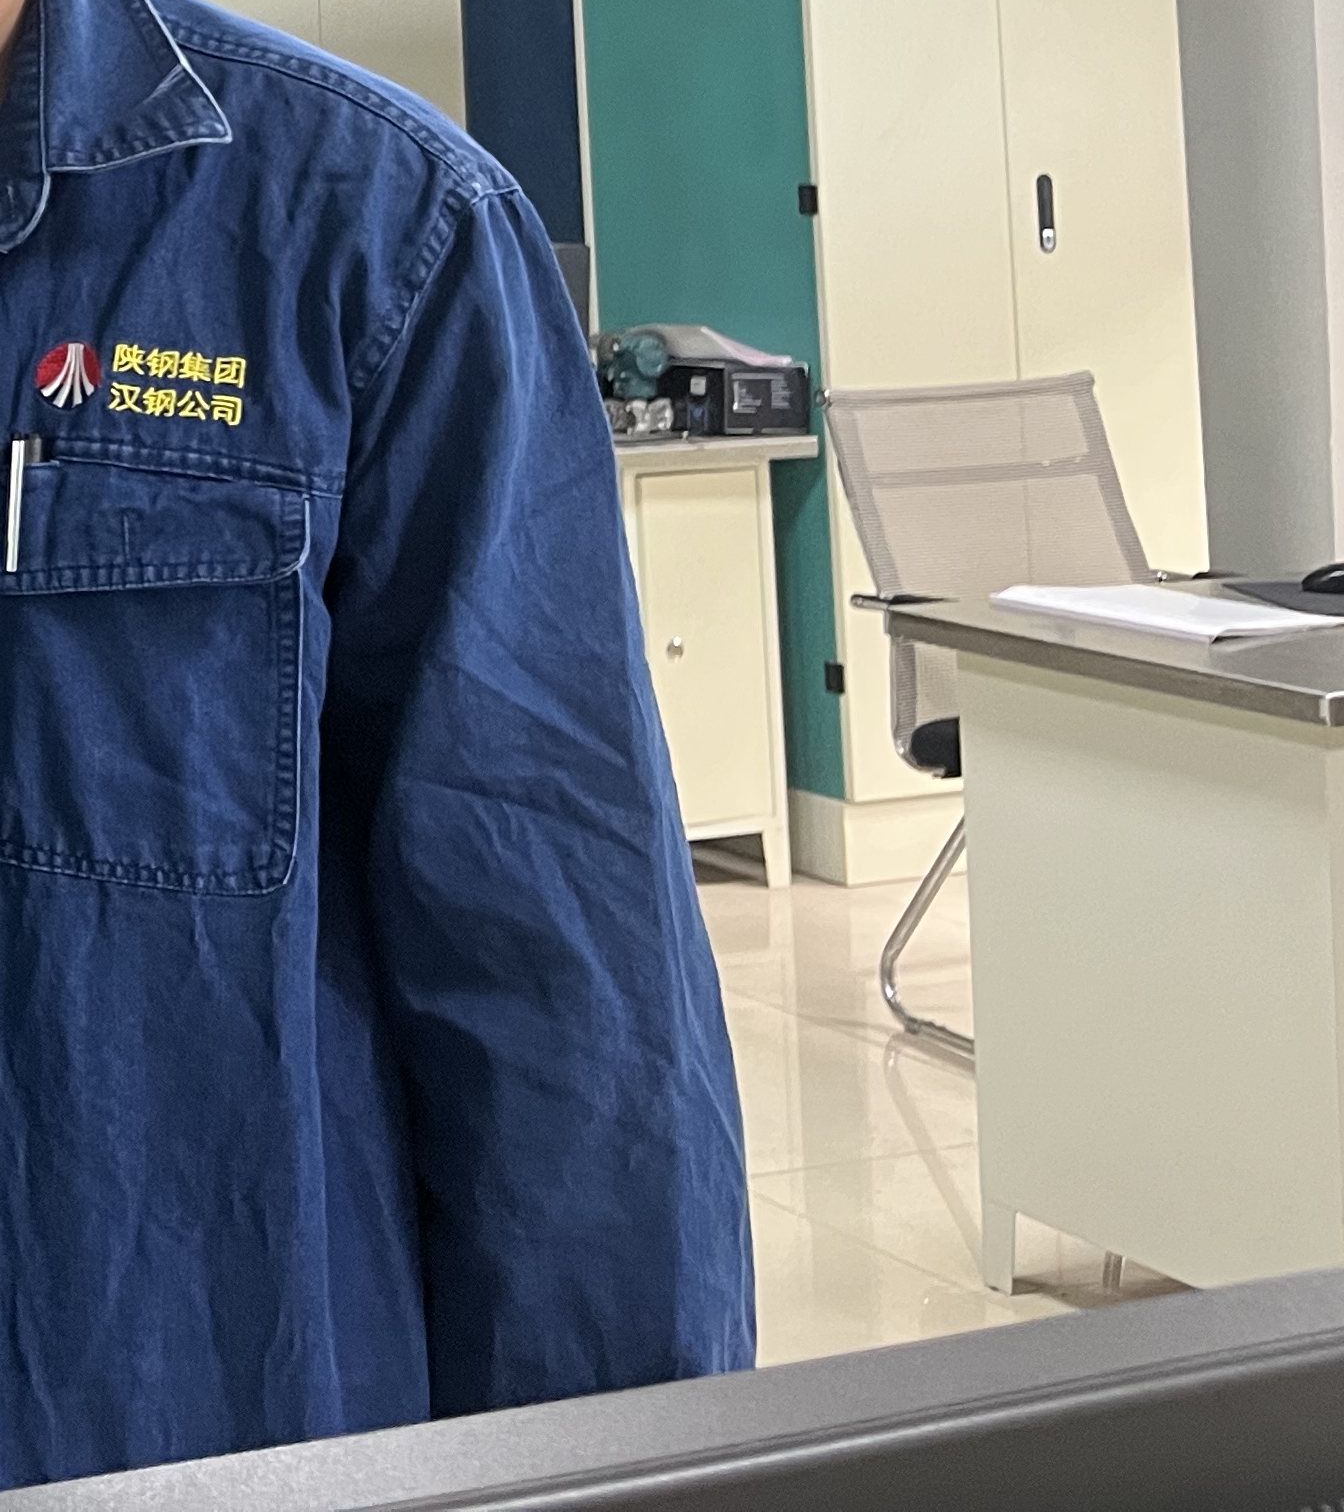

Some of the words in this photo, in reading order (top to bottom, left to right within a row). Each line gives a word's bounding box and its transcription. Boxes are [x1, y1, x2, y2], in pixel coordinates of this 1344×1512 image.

[113, 344, 246, 388] 陕钢集团
[108, 382, 243, 426] 汉钢公司
